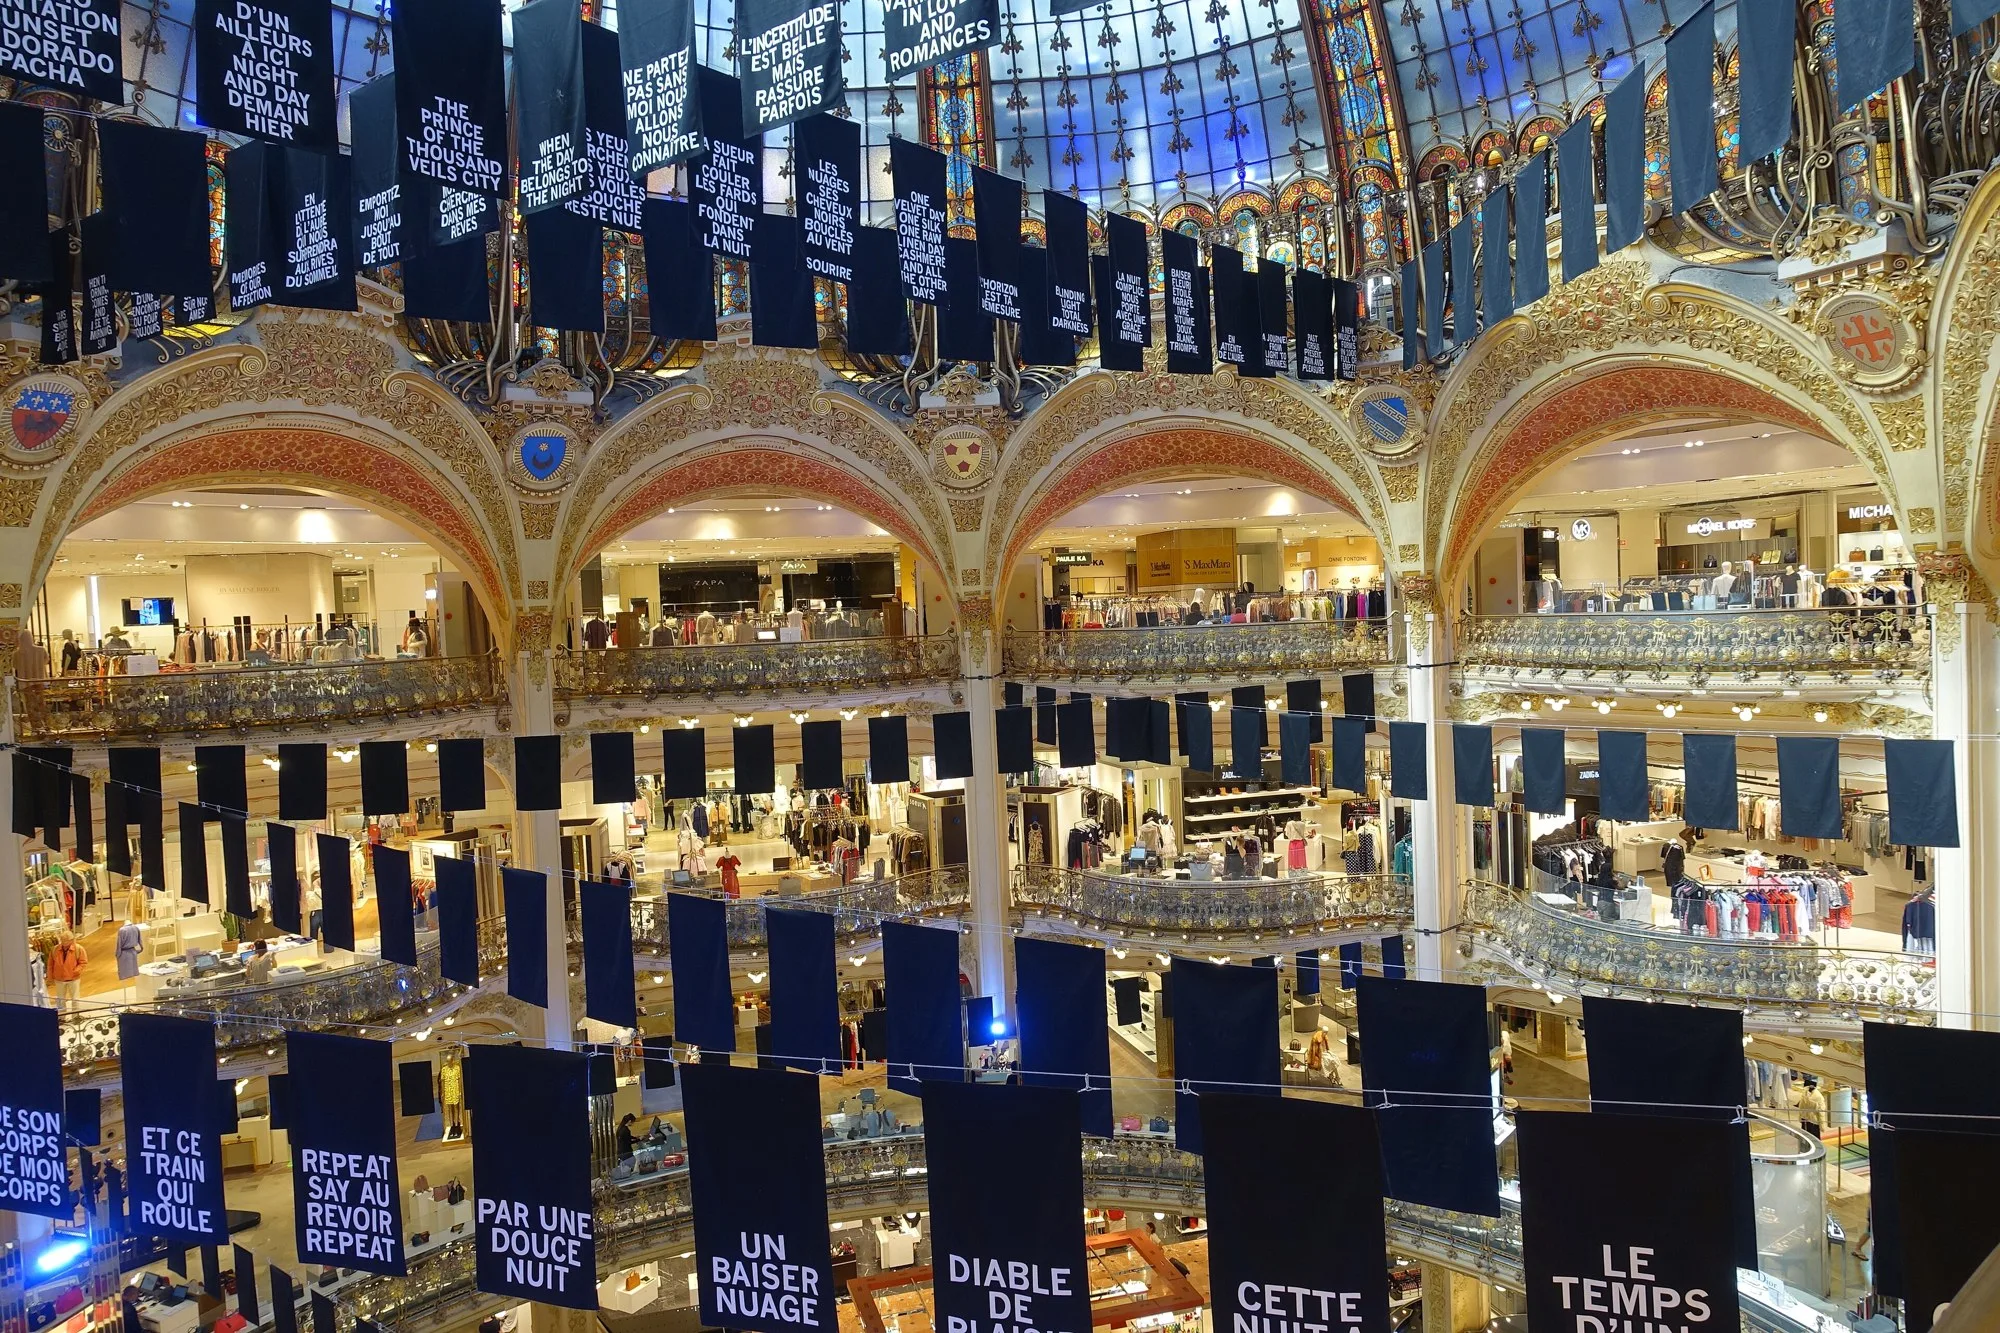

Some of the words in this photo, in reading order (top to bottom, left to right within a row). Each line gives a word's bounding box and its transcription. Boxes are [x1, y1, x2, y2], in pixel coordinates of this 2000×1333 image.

[237, 1, 290, 32] D'UN
[742, 3, 834, 55] L'INCERTITUDE
[903, 4, 922, 26] IN
[920, 11, 956, 42] AND
[216, 13, 312, 57] AILLEURS
[752, 46, 777, 72] EST
[782, 25, 826, 60] BELLE
[890, 20, 990, 72] ROMANCES
[0, 46, 85, 88] PACHA
[233, 54, 298, 88] NIGHT
[263, 46, 290, 68] ICI
[624, 68, 643, 87] NE
[647, 46, 689, 80] PARTEZ
[772, 53, 805, 84] MAIS
[224, 70, 266, 96] AND
[274, 84, 310, 109] DAY
[627, 82, 653, 102] PAS
[657, 66, 687, 94] SANS
[756, 65, 824, 106] RASSURE
[228, 88, 308, 126] DEMAIN
[434, 96, 469, 120] THE
[627, 99, 652, 120] MOI
[657, 82, 687, 111] NOUS
[760, 86, 822, 123] PARFOIS
[246, 112, 294, 140] HIER
[421, 108, 484, 140] PRINCE
[635, 103, 683, 134] ALLONS
[424, 126, 445, 144] OF
[450, 134, 484, 156] THE
[539, 133, 570, 157] WHEN
[642, 122, 678, 149] NOUS
[406, 136, 502, 176] THOUSAND
[532, 155, 553, 174] THE
[556, 146, 574, 166] DAY
[713, 154, 737, 172] FAIT
[714, 140, 754, 164] SUEUR
[409, 154, 457, 182] VEILS
[462, 170, 500, 191] CITY
[521, 165, 570, 194] BELONGS
[572, 158, 588, 175] TO
[702, 164, 750, 190] COULER
[808, 167, 850, 193] NUAGES
[819, 159, 838, 176] LES
[305, 192, 315, 207] EN
[526, 189, 548, 208] THE
[551, 176, 583, 201] NIGHT
[696, 174, 716, 193] LES
[720, 183, 756, 205] FARDS
[819, 185, 839, 201] SES
[911, 191, 929, 206] ONE
[374, 205, 388, 222] MOI
[441, 207, 464, 227] DANS
[467, 197, 486, 217] MES
[699, 204, 754, 231] FONDENT
[716, 196, 737, 213] QUI
[806, 192, 852, 220] CHEVEUX
[814, 207, 845, 229] NOIRS
[894, 198, 927, 218] VELVET
[930, 208, 945, 222] DAY
[612, 210, 641, 230] NUE
[713, 221, 744, 241] DANS
[899, 212, 919, 227] ONE
[922, 218, 941, 233] SILK
[371, 231, 391, 250] BOUT
[704, 233, 719, 249] LA
[723, 238, 751, 256] NUIT
[806, 232, 822, 246] AU
[825, 236, 852, 255] VENT
[898, 234, 925, 252] LINEN
[928, 244, 944, 256] DAY
[900, 225, 920, 239] ONE
[922, 230, 942, 244] RAW
[363, 251, 376, 264] DE
[378, 242, 400, 261] TOUT
[286, 275, 302, 287] DU
[806, 257, 852, 281] SOURIRE
[901, 270, 916, 285] THE
[919, 276, 947, 291] OTHER
[903, 260, 923, 274] AND
[926, 266, 942, 278] ALL
[1118, 271, 1124, 281] LA
[1127, 274, 1141, 286] NUIT
[1171, 268, 1191, 281] BAISER
[232, 286, 272, 308] AFFECTION
[240, 282, 248, 295] OF
[249, 276, 261, 291] OUR
[913, 286, 935, 300] DAYS
[985, 290, 1001, 302] EST
[1003, 294, 1012, 306] TA
[1116, 280, 1144, 297] COMPLICE
[1122, 292, 1139, 304] NOUS
[1061, 298, 1080, 311] LIGHT
[1062, 308, 1081, 322] TOTAL
[1116, 310, 1132, 321] AVEC
[1133, 314, 1146, 325] UNE
[1122, 302, 1140, 314] PORTE
[1052, 316, 1089, 333] DARKNESS
[1120, 330, 1144, 343] INFINIE
[1176, 324, 1192, 335] DOUX
[1176, 333, 1194, 344] BLANC
[1193, 559, 1231, 569] MaxMara
[18, 1109, 60, 1134] SON
[0, 1128, 59, 1158] CORPS
[142, 1126, 170, 1150] ET
[177, 1130, 201, 1157] CE
[21, 1155, 65, 1184] MON
[140, 1152, 205, 1183] TRAIN
[302, 1149, 390, 1180] REPEAT
[0, 1176, 61, 1206] CORPS
[157, 1178, 194, 1208] QUI
[308, 1176, 349, 1202] SAY
[360, 1180, 390, 1207] AU
[141, 1200, 214, 1234] ROULE
[307, 1202, 392, 1235] REVOIR
[478, 1199, 529, 1228] PAR
[539, 1206, 592, 1240] UNE
[306, 1229, 395, 1262] REPEAT
[492, 1227, 581, 1267] DOUCE
[741, 1232, 786, 1260] UN
[506, 1257, 569, 1292] NUIT
[712, 1256, 819, 1296] BAISER
[950, 1254, 1072, 1296] DIABLE
[1603, 1244, 1655, 1281] LE
[716, 1286, 819, 1326] NUAGE
[989, 1291, 1033, 1324] DE
[1238, 1281, 1362, 1322] CETTE
[1553, 1276, 1711, 1322] TEMPS
